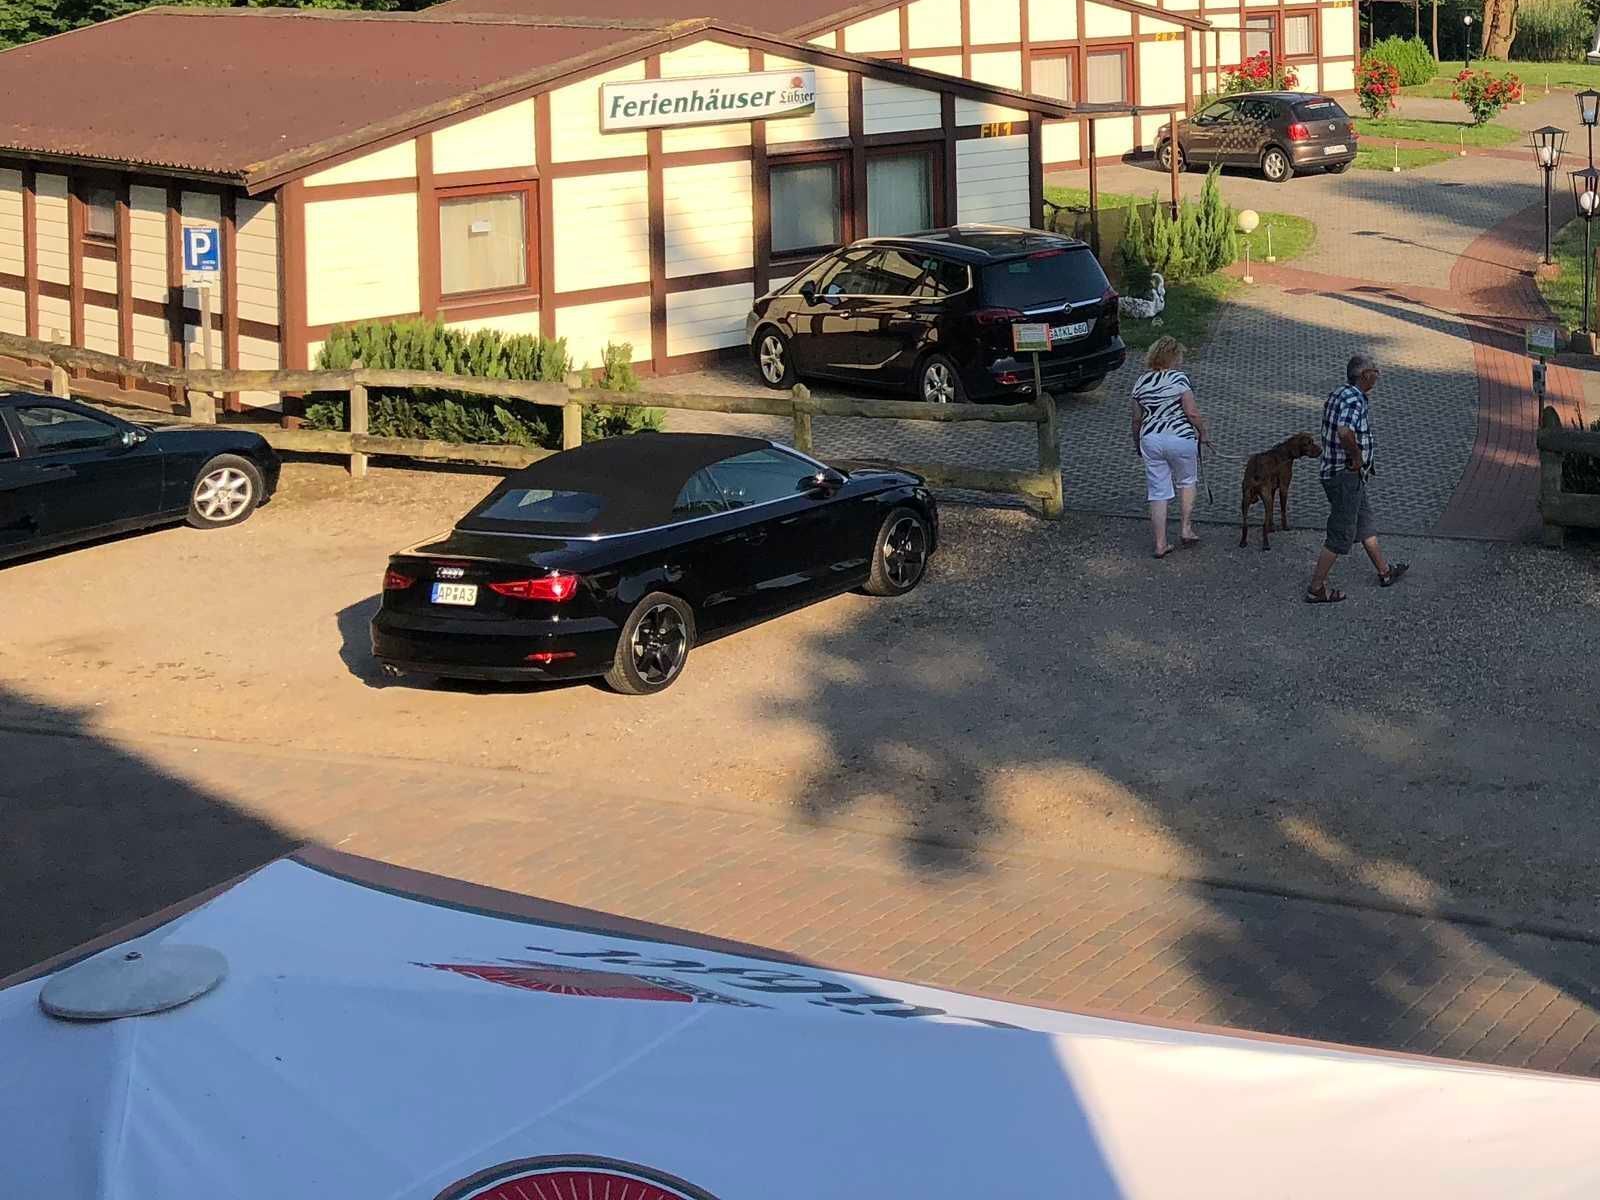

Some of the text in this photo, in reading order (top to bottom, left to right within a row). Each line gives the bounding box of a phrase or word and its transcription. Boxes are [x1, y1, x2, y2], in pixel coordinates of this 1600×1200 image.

[610, 88, 776, 119] Ferienhäuser
[980, 121, 1012, 138] FH 1
[191, 232, 211, 266] P
